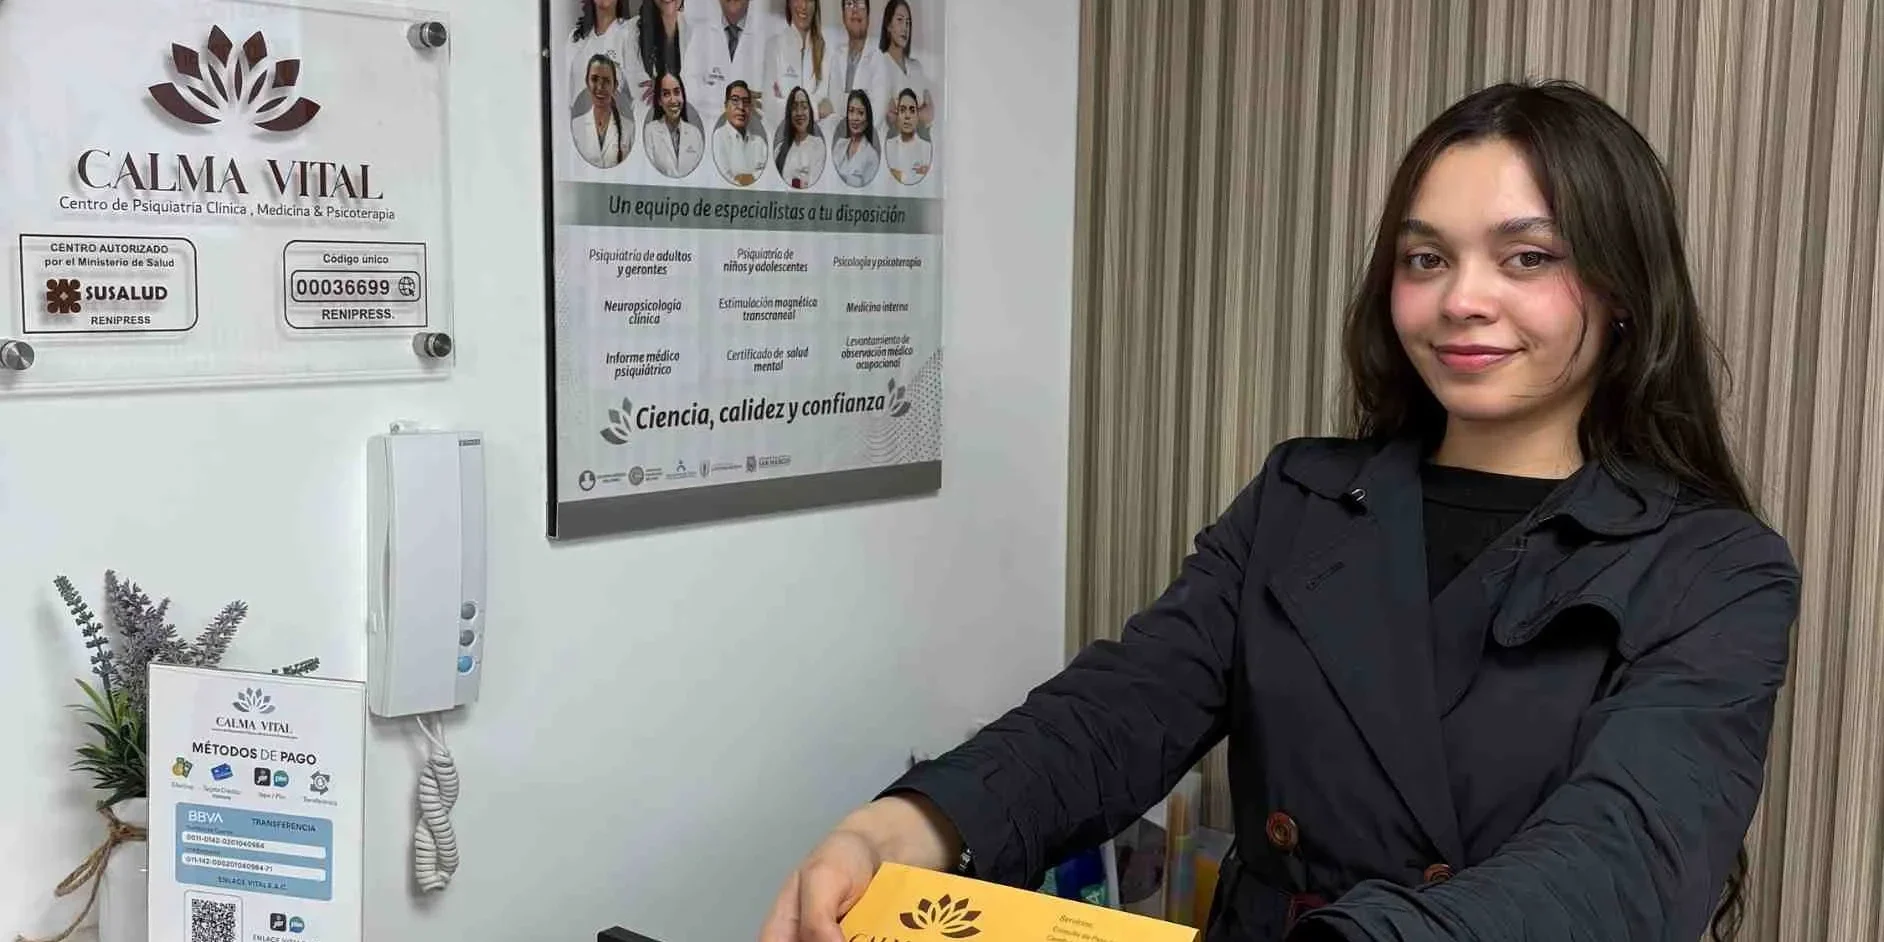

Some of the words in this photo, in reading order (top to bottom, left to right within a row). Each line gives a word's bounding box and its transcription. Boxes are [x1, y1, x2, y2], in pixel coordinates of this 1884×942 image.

[77, 148, 249, 194] CALMA
[266, 158, 384, 199] VITAL
[59, 196, 108, 211] Centro
[112, 197, 129, 211] de
[133, 199, 202, 215] Psiquiatría
[206, 201, 247, 215] Clínica
[257, 203, 311, 217] Medicina
[314, 205, 323, 216] &
[327, 206, 396, 222] Psicoterapia
[608, 195, 632, 215] Un
[635, 196, 690, 222] equipo
[693, 197, 712, 217] de
[714, 199, 805, 224] especialistas
[807, 205, 817, 220] a
[819, 206, 833, 221] tu
[835, 203, 906, 226] disposición
[50, 243, 97, 253] CENTRO
[99, 243, 169, 254] AUTORIZADO
[589, 248, 642, 263] Psiquiatría
[642, 249, 655, 262] de
[656, 249, 692, 262] adultos
[737, 247, 783, 262] Psiquiatría
[783, 248, 794, 259] de
[44, 258, 62, 268] por
[66, 257, 75, 266] el
[78, 257, 129, 267] Ministerio
[131, 258, 144, 267] de
[147, 258, 175, 268] Salud
[323, 254, 359, 266] Código
[362, 254, 389, 264] único
[723, 260, 748, 272] niños
[748, 262, 755, 275] y
[755, 260, 808, 273] adolescentes
[616, 265, 624, 278] y
[625, 264, 668, 278] gerontes
[85, 285, 168, 301] SUSALUD
[296, 279, 390, 296] 00036699
[604, 297, 682, 314] Neuropsicología
[718, 296, 774, 310] Estimulación
[774, 295, 818, 311] magnética
[846, 301, 881, 313] Medicina
[90, 315, 151, 325] RENIPRESS
[628, 312, 661, 325] clínica
[743, 308, 796, 321] transcraneal
[606, 351, 645, 365] Informe
[646, 349, 681, 363] médico
[726, 348, 773, 361] Certificado
[774, 347, 784, 359] de
[786, 346, 809, 359] salud
[614, 362, 672, 380] psiquiátrico
[753, 359, 784, 373] mental
[635, 401, 715, 431] Ciencia,
[719, 396, 785, 424] calidez
[786, 399, 800, 425] y
[802, 391, 886, 417] confianza
[216, 716, 256, 730] CALMA
[260, 720, 293, 734] VITAL
[192, 740, 258, 760] MÉTODOS
[260, 750, 277, 762] DE
[280, 751, 317, 765] PAGO
[188, 810, 223, 824] BBVA
[251, 817, 316, 833] TRANSFERENCIA
